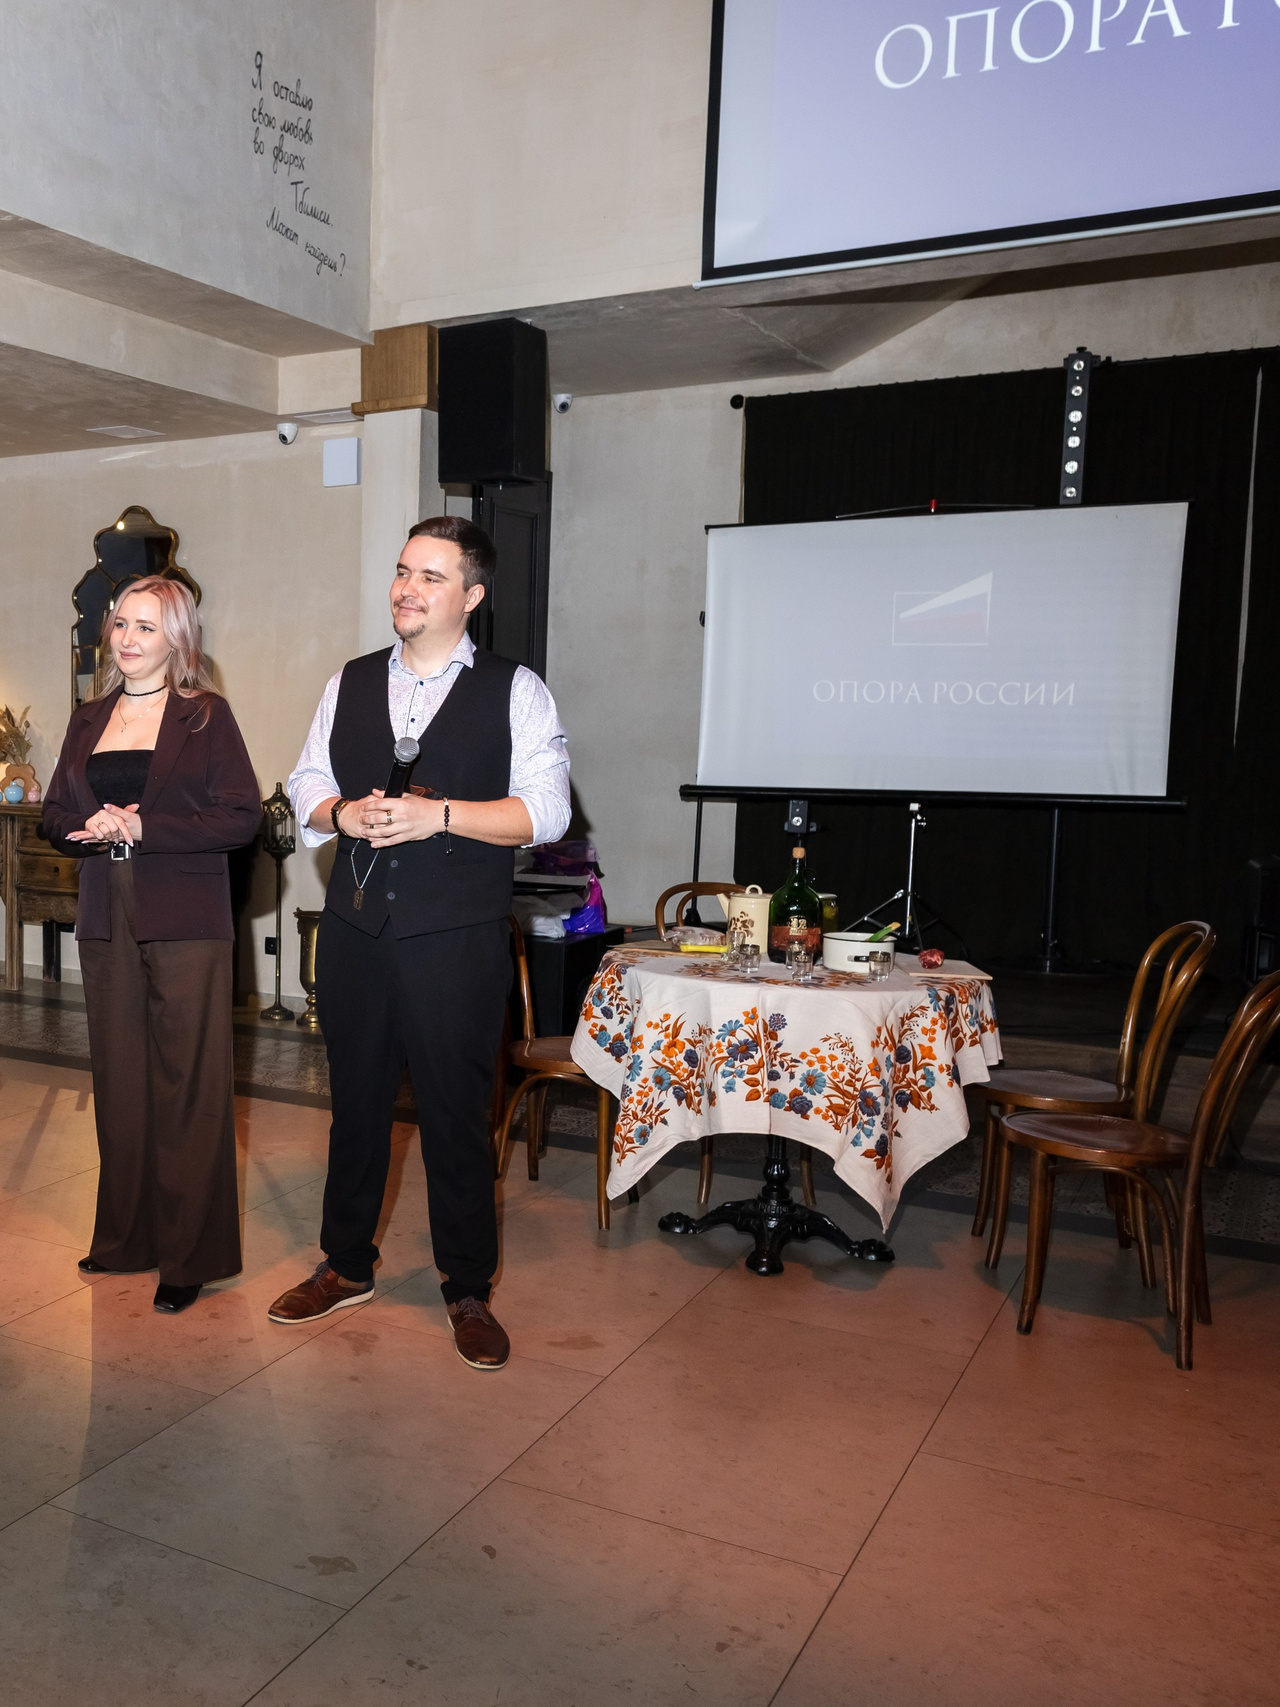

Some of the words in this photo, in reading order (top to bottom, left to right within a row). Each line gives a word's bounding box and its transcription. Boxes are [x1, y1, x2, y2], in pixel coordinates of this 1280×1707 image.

[875, 0, 1191, 89] ОПОРА
[252, 51, 263, 90] Я
[273, 78, 313, 111] оставлю
[252, 97, 276, 129] свою
[280, 116, 313, 146] любовь
[253, 126, 265, 155] во
[266, 206, 299, 245] Может
[812, 680, 923, 704] ОПОРА
[933, 681, 1076, 706] РОССИИ
